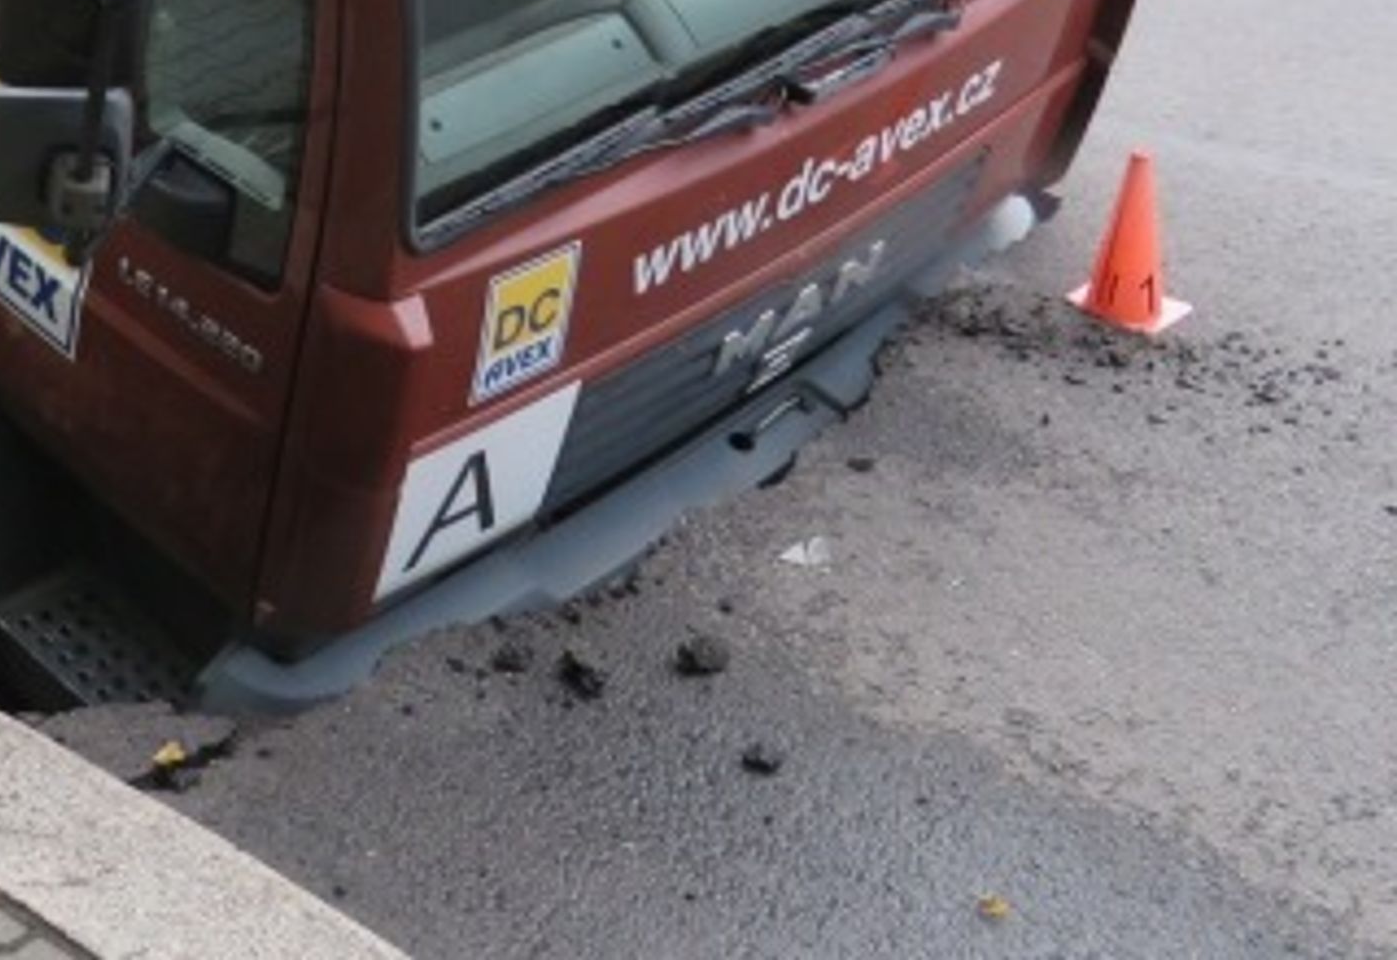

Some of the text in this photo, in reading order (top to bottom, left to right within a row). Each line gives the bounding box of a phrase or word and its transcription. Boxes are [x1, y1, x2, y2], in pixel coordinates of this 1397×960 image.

[633, 60, 1002, 296] www.dc-avex.cz
[484, 337, 552, 388] AVEX
[493, 288, 560, 352] DC
[717, 239, 885, 376] MAN
[402, 449, 495, 573] A
